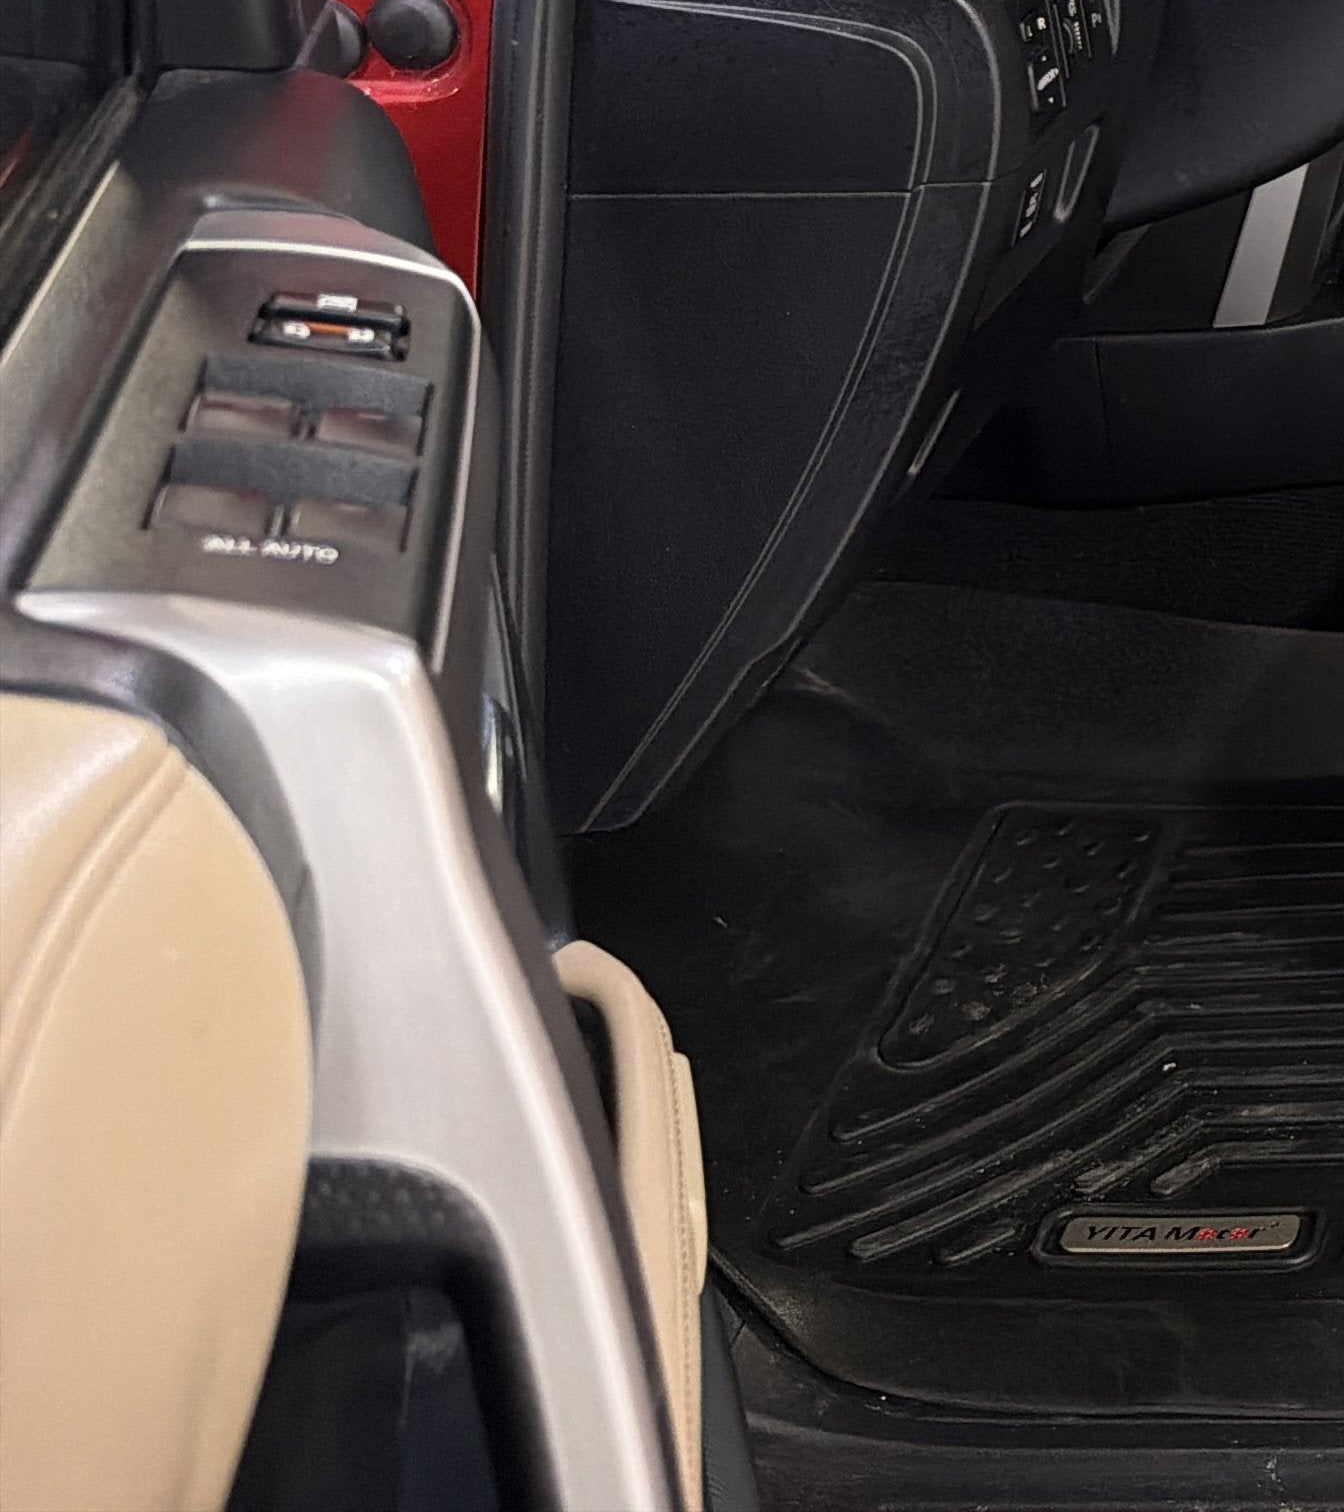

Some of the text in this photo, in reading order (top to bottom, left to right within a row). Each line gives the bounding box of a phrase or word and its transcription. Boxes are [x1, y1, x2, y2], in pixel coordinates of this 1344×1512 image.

[201, 534, 340, 565] ALL AUTO
[1085, 1225, 1157, 1242] YITA
